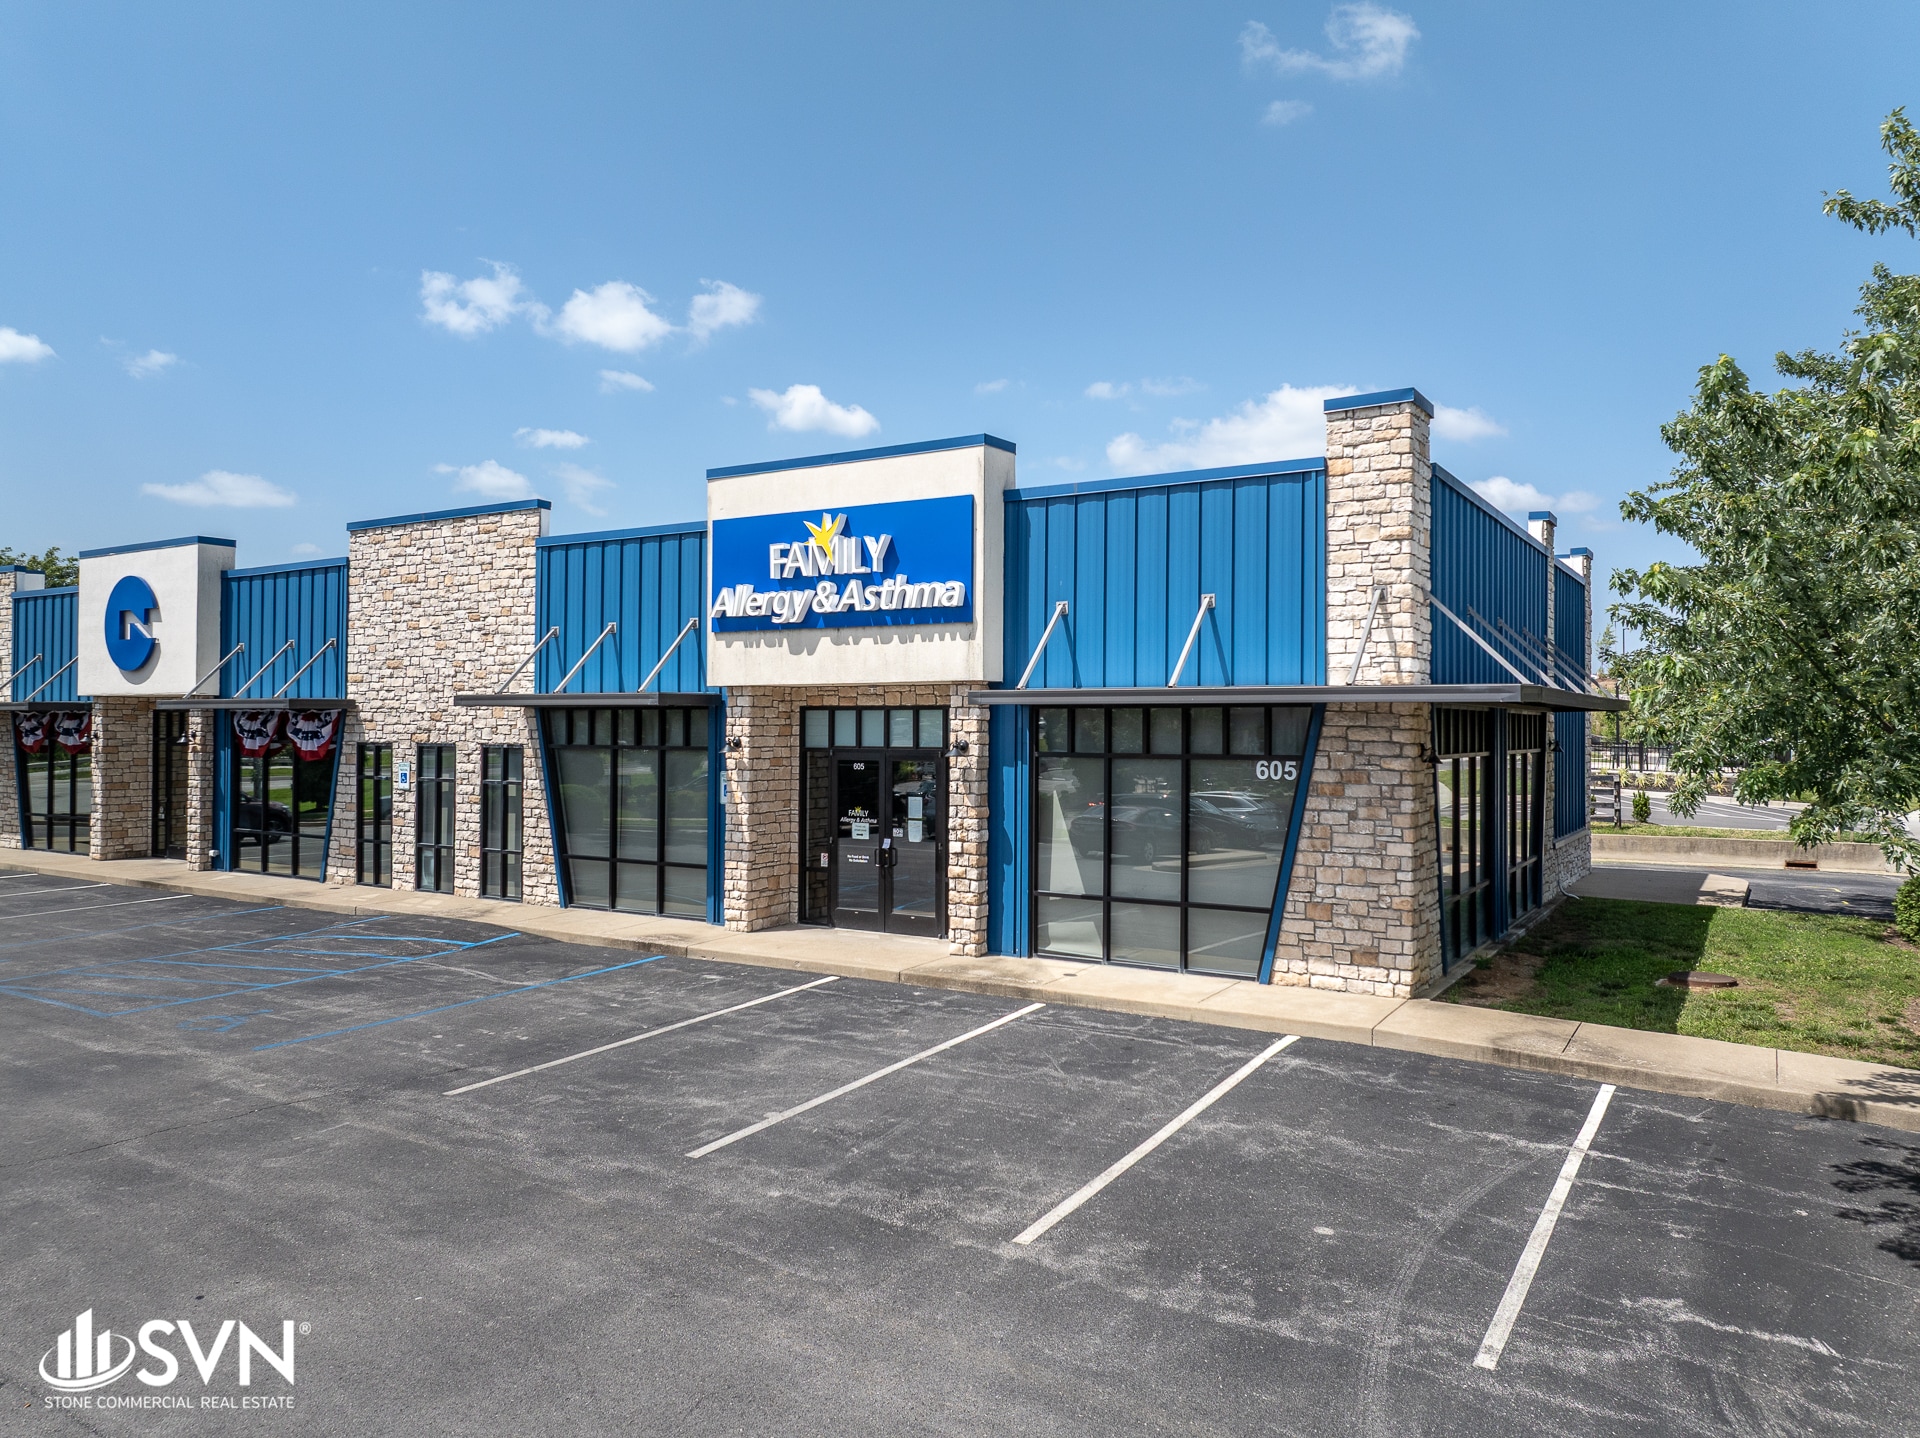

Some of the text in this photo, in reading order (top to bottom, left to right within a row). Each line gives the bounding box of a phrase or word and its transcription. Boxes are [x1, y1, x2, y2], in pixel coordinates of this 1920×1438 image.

[769, 533, 892, 580] FAMILY
[710, 574, 966, 624] Allergy & Asthma
[853, 762, 865, 770] 605
[1256, 760, 1297, 780] 605
[848, 809, 869, 817] FAMILY
